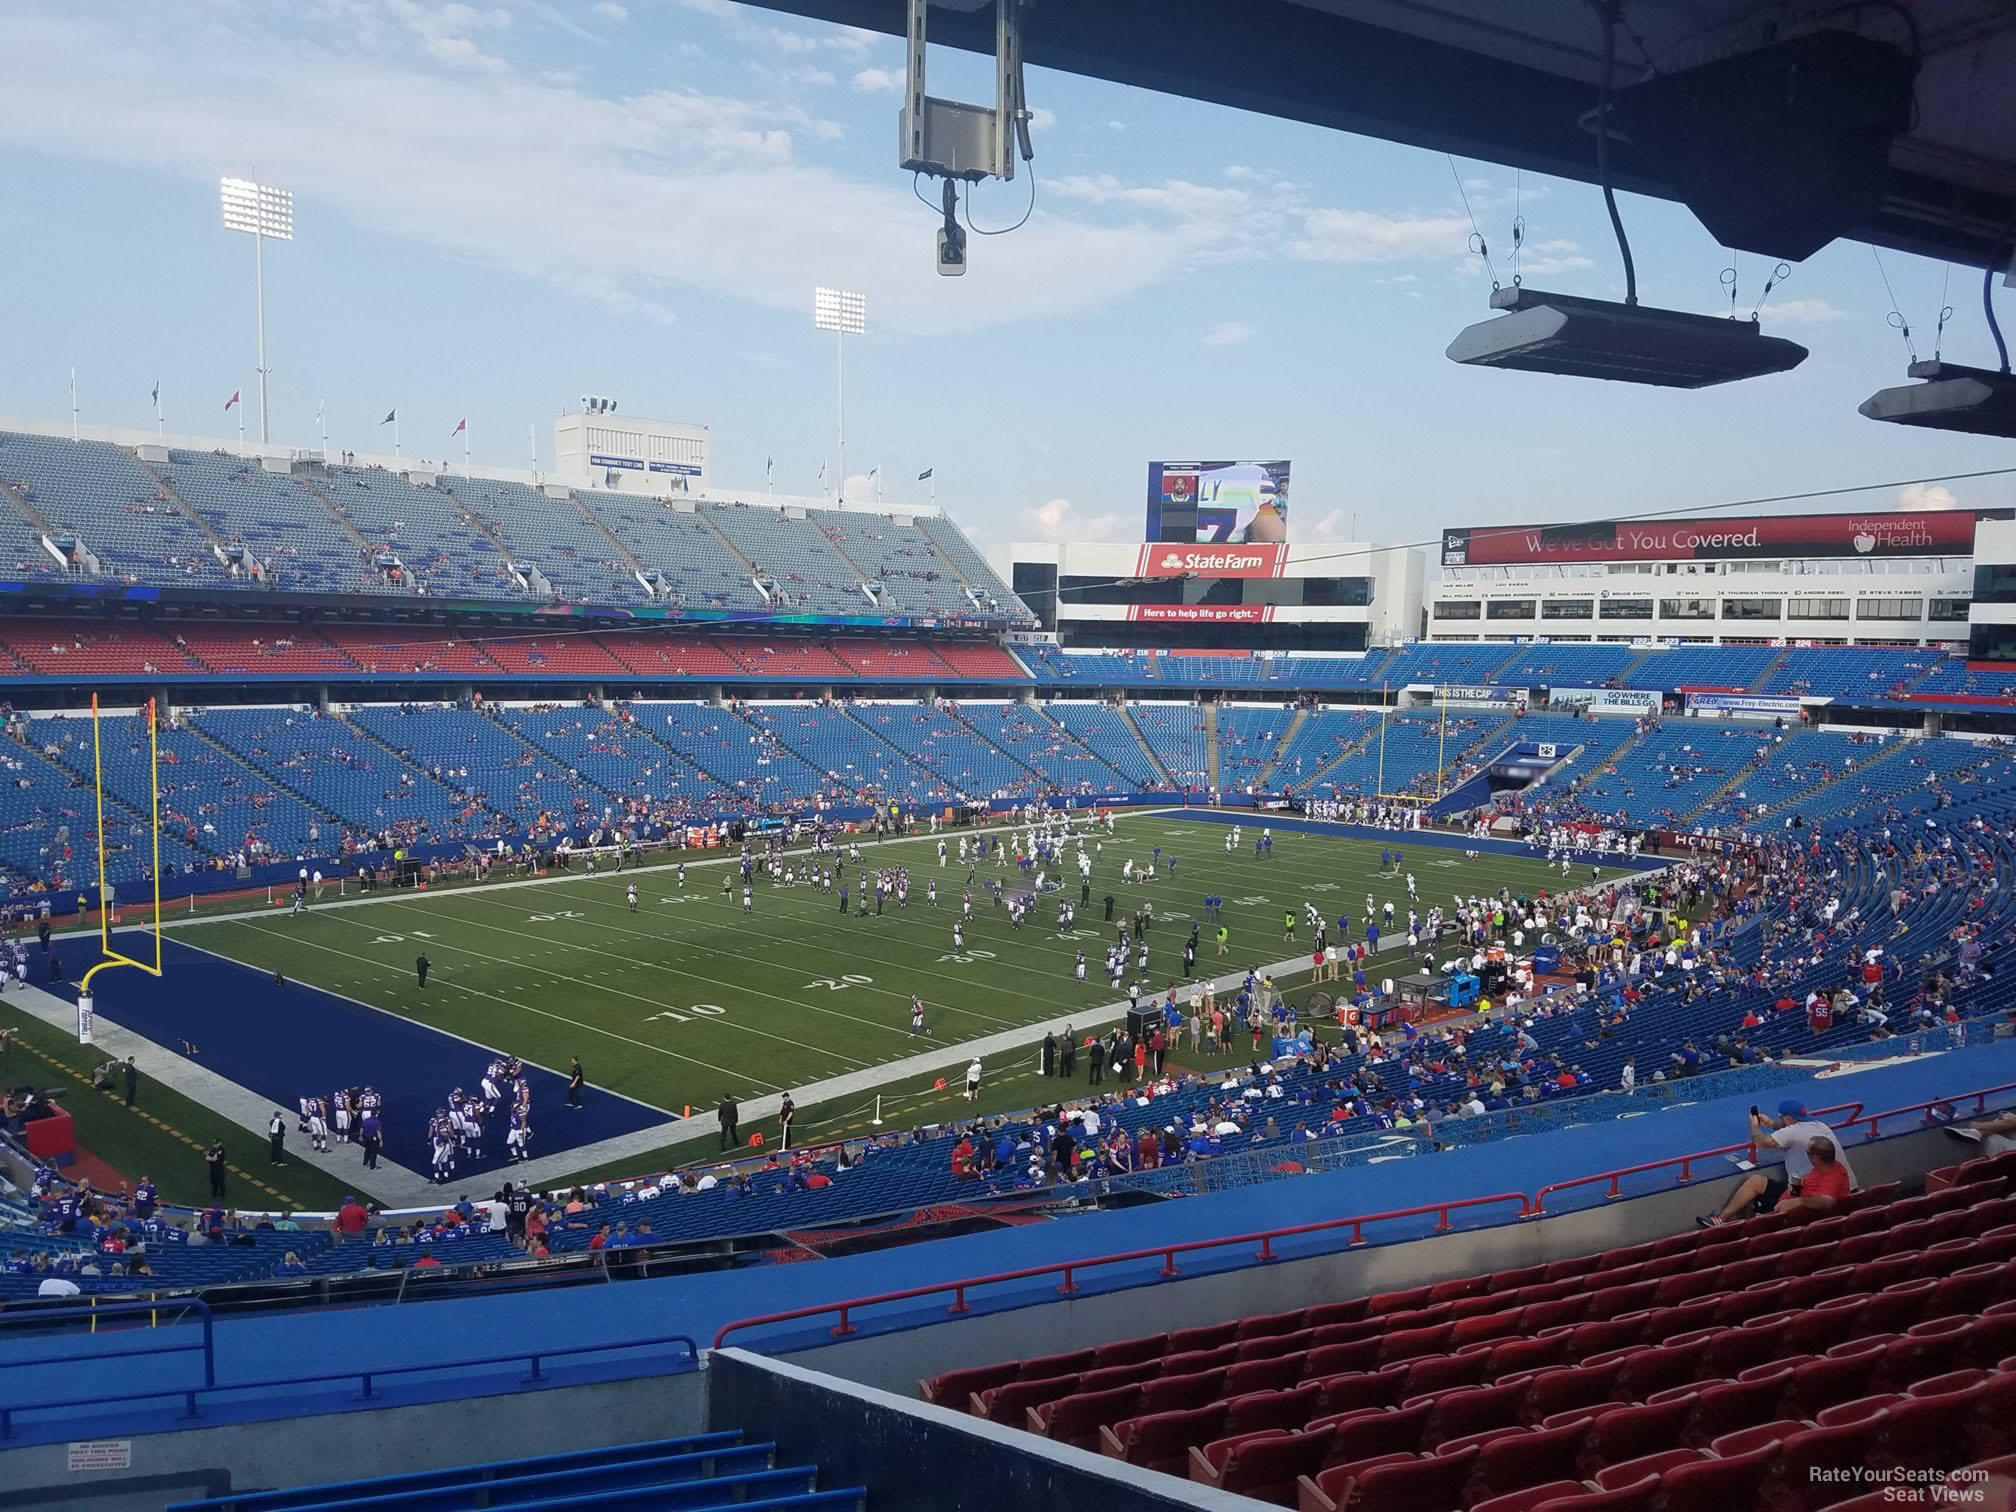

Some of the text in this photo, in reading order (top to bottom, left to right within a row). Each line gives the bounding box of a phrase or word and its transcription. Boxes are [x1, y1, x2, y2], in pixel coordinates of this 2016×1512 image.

[1848, 518, 1926, 534] Independent
[1630, 531, 1666, 549] You
[1672, 527, 1762, 549] Covered.
[1877, 530, 1932, 547] Health
[1143, 608, 1165, 617] Here
[1167, 609, 1176, 617] to
[1178, 608, 1198, 619] help
[1199, 609, 1214, 618] life
[1216, 611, 1228, 620] go
[1771, 639, 1786, 647] 223
[1795, 639, 1811, 647] 224
[1460, 688, 1476, 698] THE
[1476, 688, 1492, 698] CAP
[1722, 699, 1799, 708] www.Frey-Electric.com
[811, 974, 873, 991] 20
[655, 1004, 727, 1023] 10
[1815, 1007, 1829, 1017] 55
